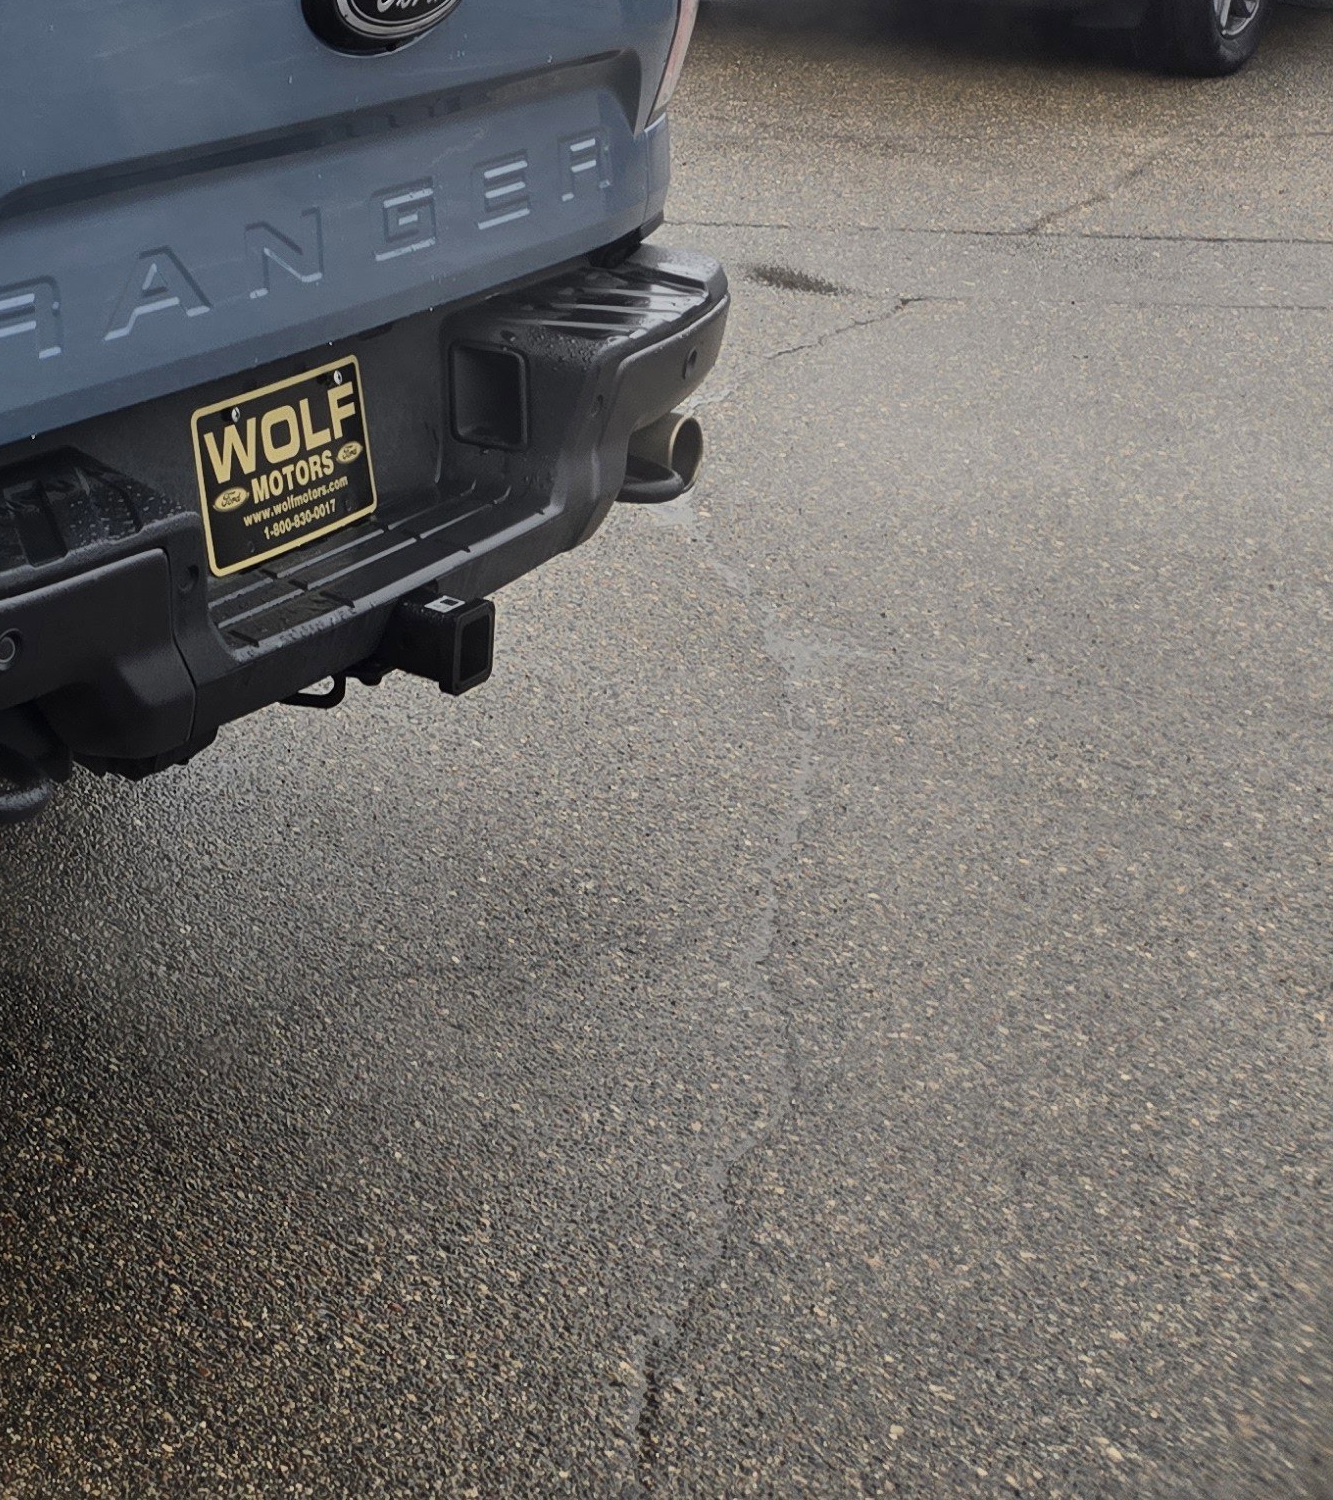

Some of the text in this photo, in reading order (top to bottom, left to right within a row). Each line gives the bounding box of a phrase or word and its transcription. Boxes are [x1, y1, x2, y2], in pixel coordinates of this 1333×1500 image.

[203, 381, 356, 484] WOLF
[243, 475, 348, 527] www.wolfmotors.com
[251, 450, 335, 504] MOTORS
[264, 499, 336, 539] 1-800-830-0017
